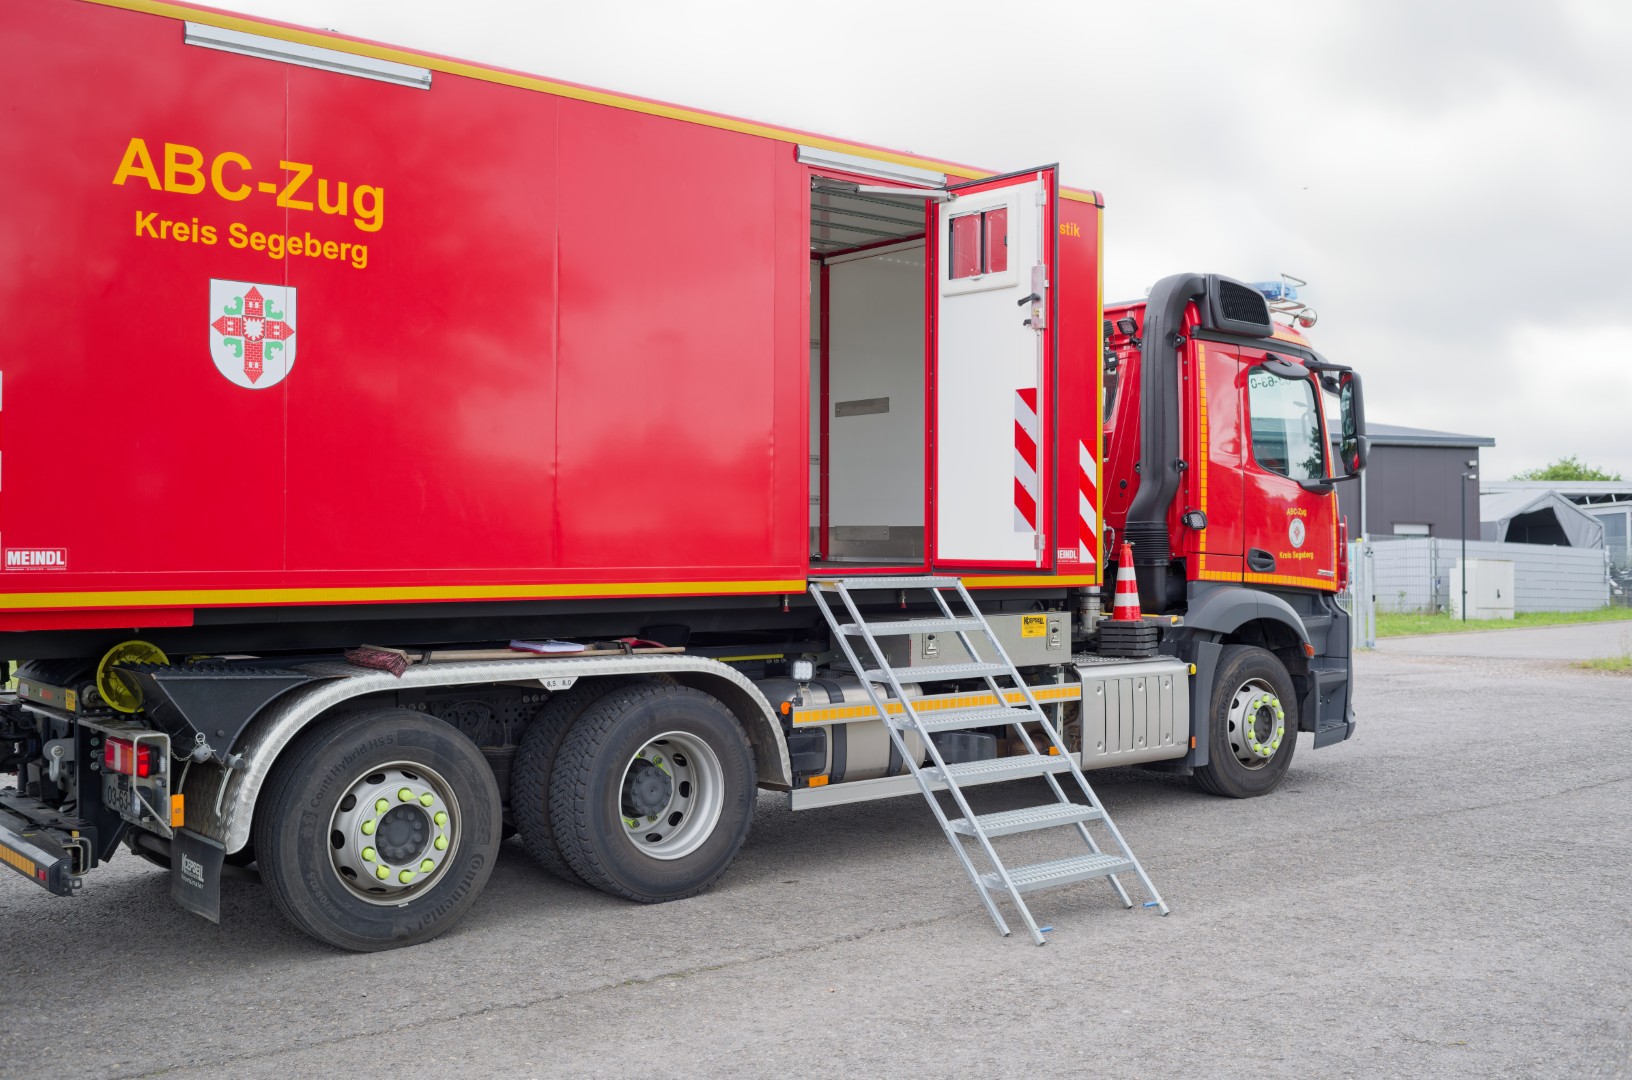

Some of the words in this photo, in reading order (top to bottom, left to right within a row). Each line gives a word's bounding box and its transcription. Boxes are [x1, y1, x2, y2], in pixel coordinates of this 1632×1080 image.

[113, 138, 384, 232] ABC-Zug
[136, 211, 217, 244] Kreis
[229, 223, 368, 268] Segeberg
[1286, 507, 1307, 517] ABC-Zug
[7, 551, 65, 565] MEINDL
[1279, 551, 1292, 559] Kreis
[1292, 550, 1314, 560] Segeberg
[311, 774, 333, 808] Conti
[330, 744, 368, 777] Hybrid
[418, 853, 485, 930] Continental
